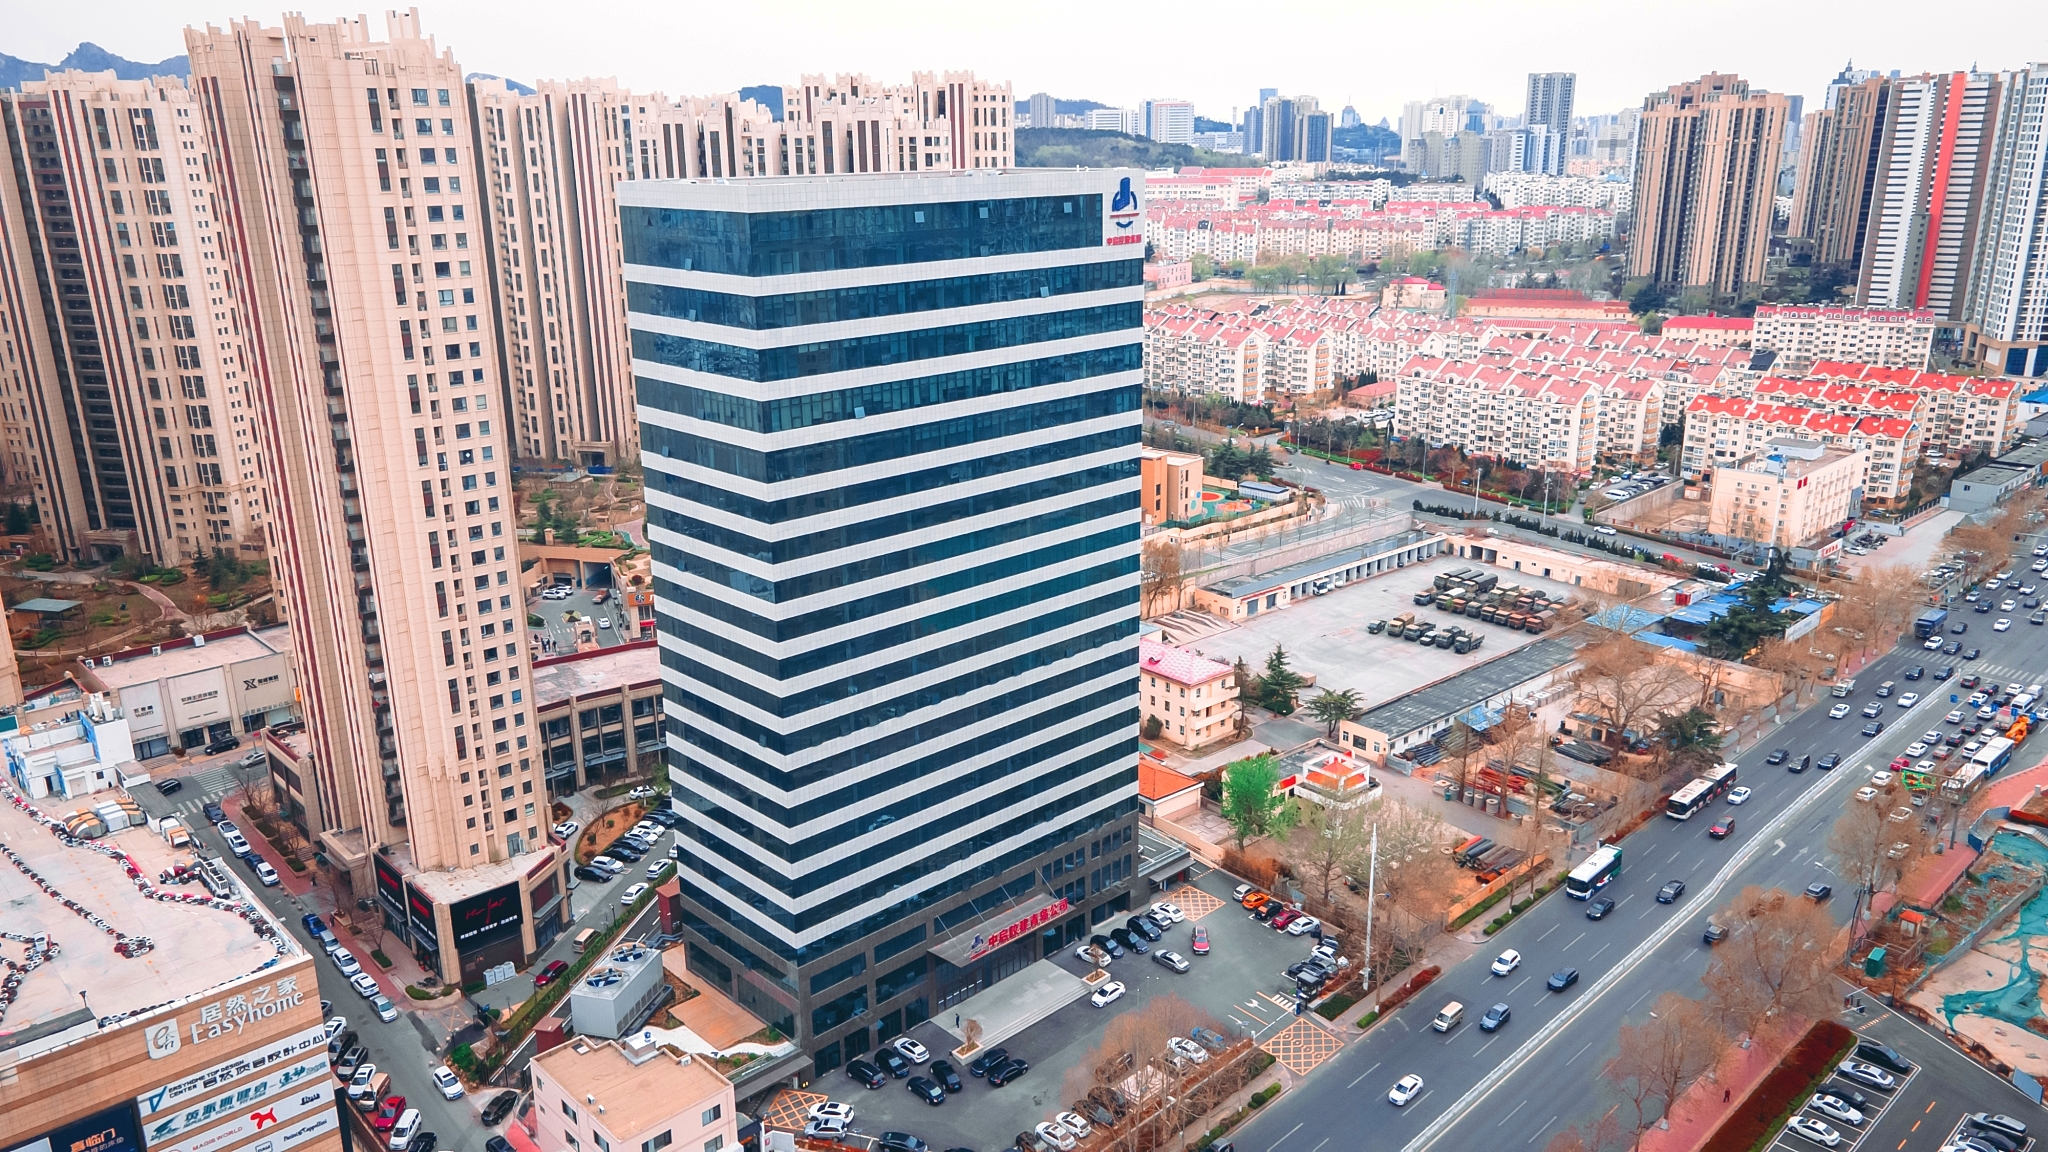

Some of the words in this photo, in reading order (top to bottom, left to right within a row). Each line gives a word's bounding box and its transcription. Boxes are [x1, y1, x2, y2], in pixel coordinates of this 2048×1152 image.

[201, 975, 298, 1025] 居然之家
[190, 991, 305, 1045] Easyhome
[168, 1075, 206, 1093] EASYHOME
[206, 1069, 220, 1078] TOP
[220, 1060, 244, 1073] DESIGN
[169, 1084, 197, 1099] CENTER
[216, 1126, 243, 1141] WORLD
